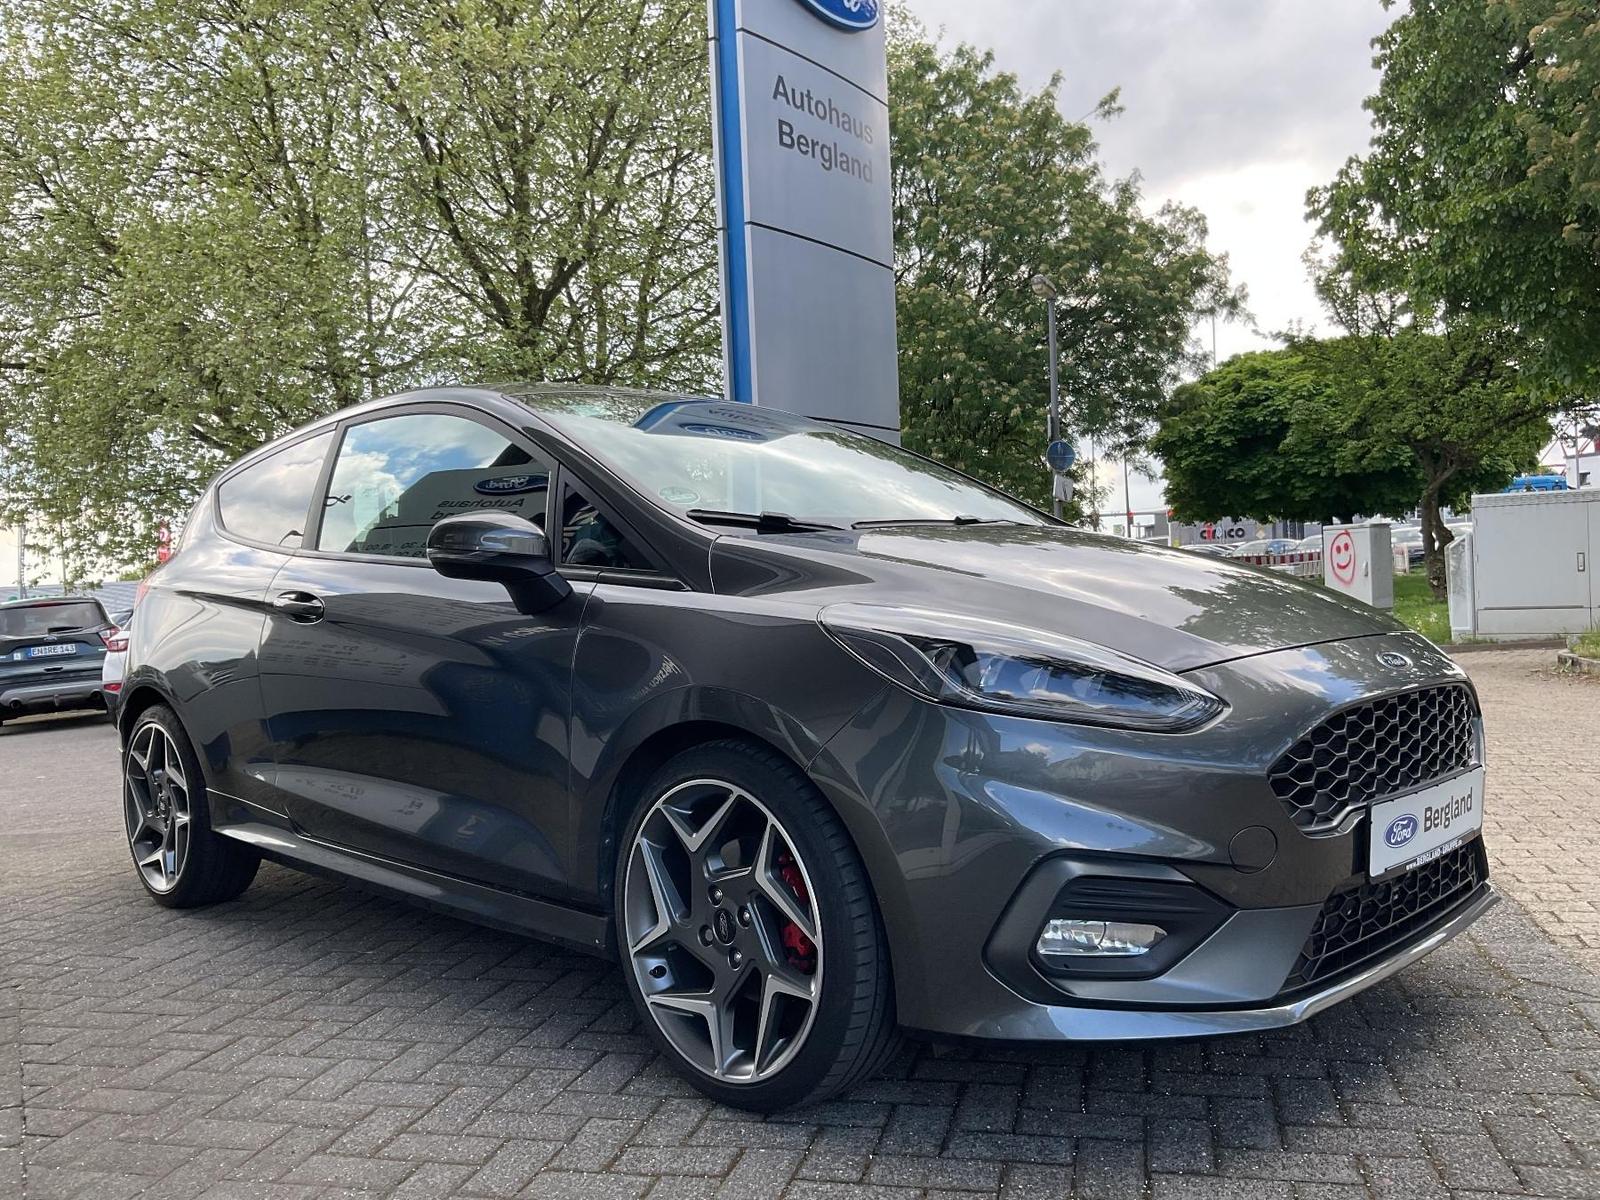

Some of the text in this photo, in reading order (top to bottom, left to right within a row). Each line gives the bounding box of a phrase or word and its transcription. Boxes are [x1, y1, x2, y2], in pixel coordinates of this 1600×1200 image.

[772, 75, 873, 145] Autohaus
[778, 119, 873, 183] Bergland
[1389, 787, 1473, 844] Ford Bergland
